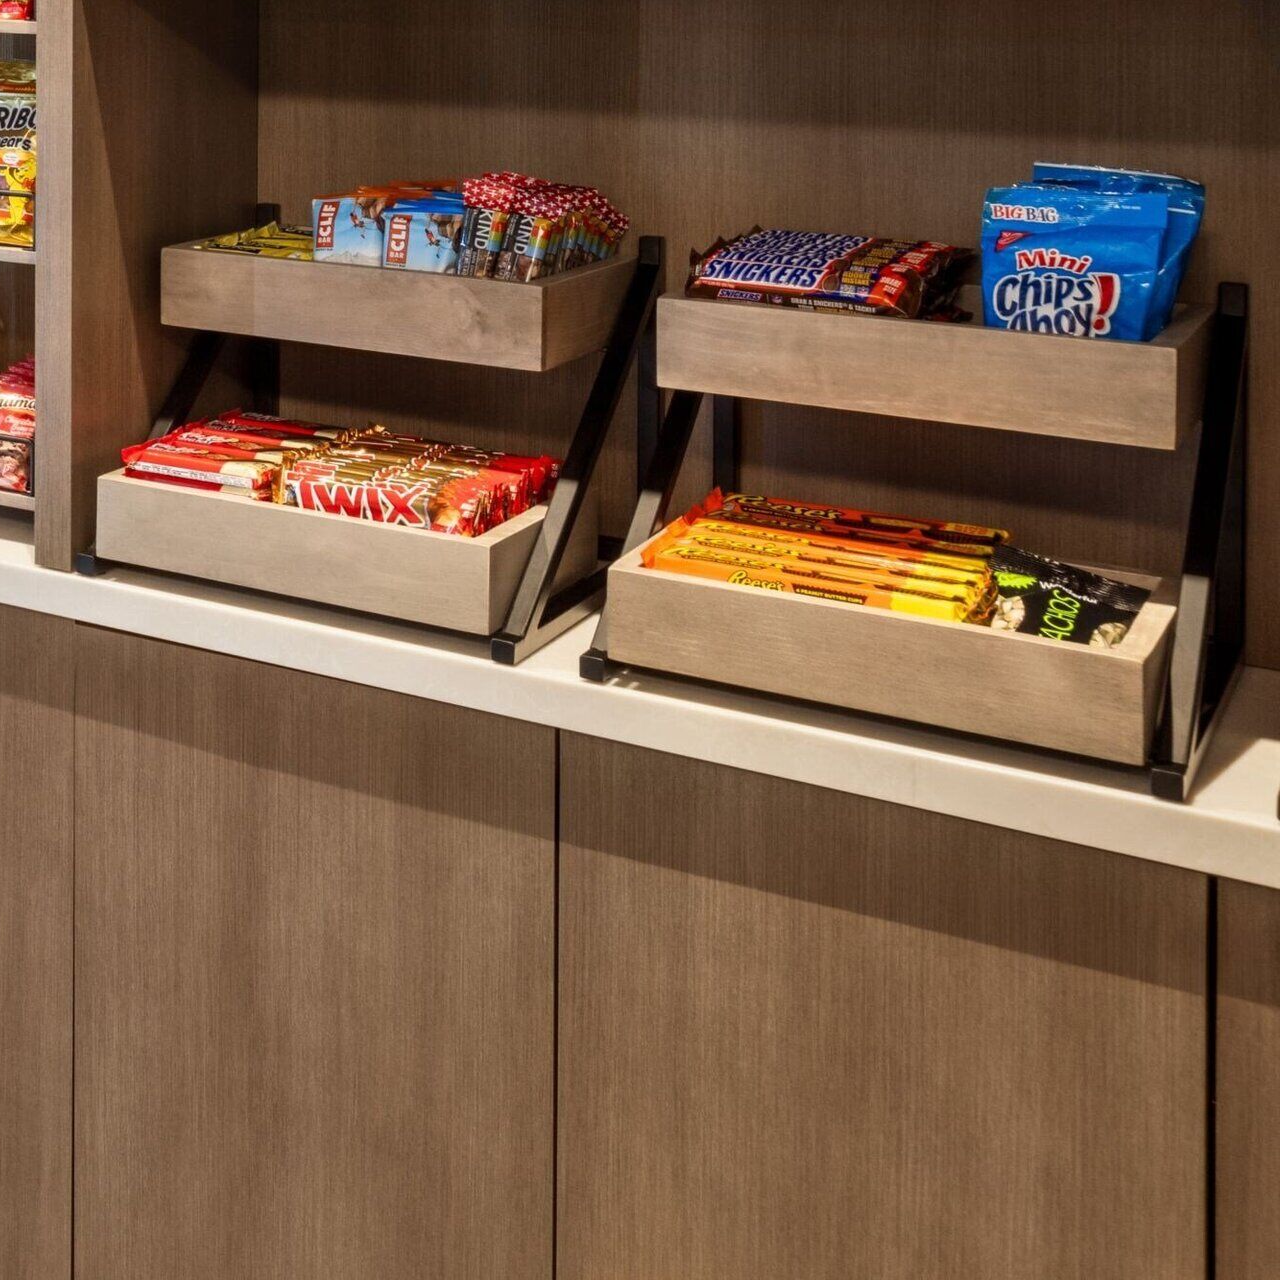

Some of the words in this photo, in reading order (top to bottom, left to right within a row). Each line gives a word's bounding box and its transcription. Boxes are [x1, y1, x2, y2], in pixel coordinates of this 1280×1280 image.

[321, 203, 337, 237] CLIF
[992, 205, 1023, 219] BIG
[1027, 207, 1056, 222] BAG
[474, 208, 494, 250] KIND
[514, 215, 536, 255] KIND
[318, 237, 332, 248] BAR
[706, 259, 821, 288] SNICKERS
[1017, 251, 1091, 274] Mini
[719, 289, 761, 301] SNICKERS
[298, 482, 428, 527] TWIX
[728, 570, 785, 592] Reese's
